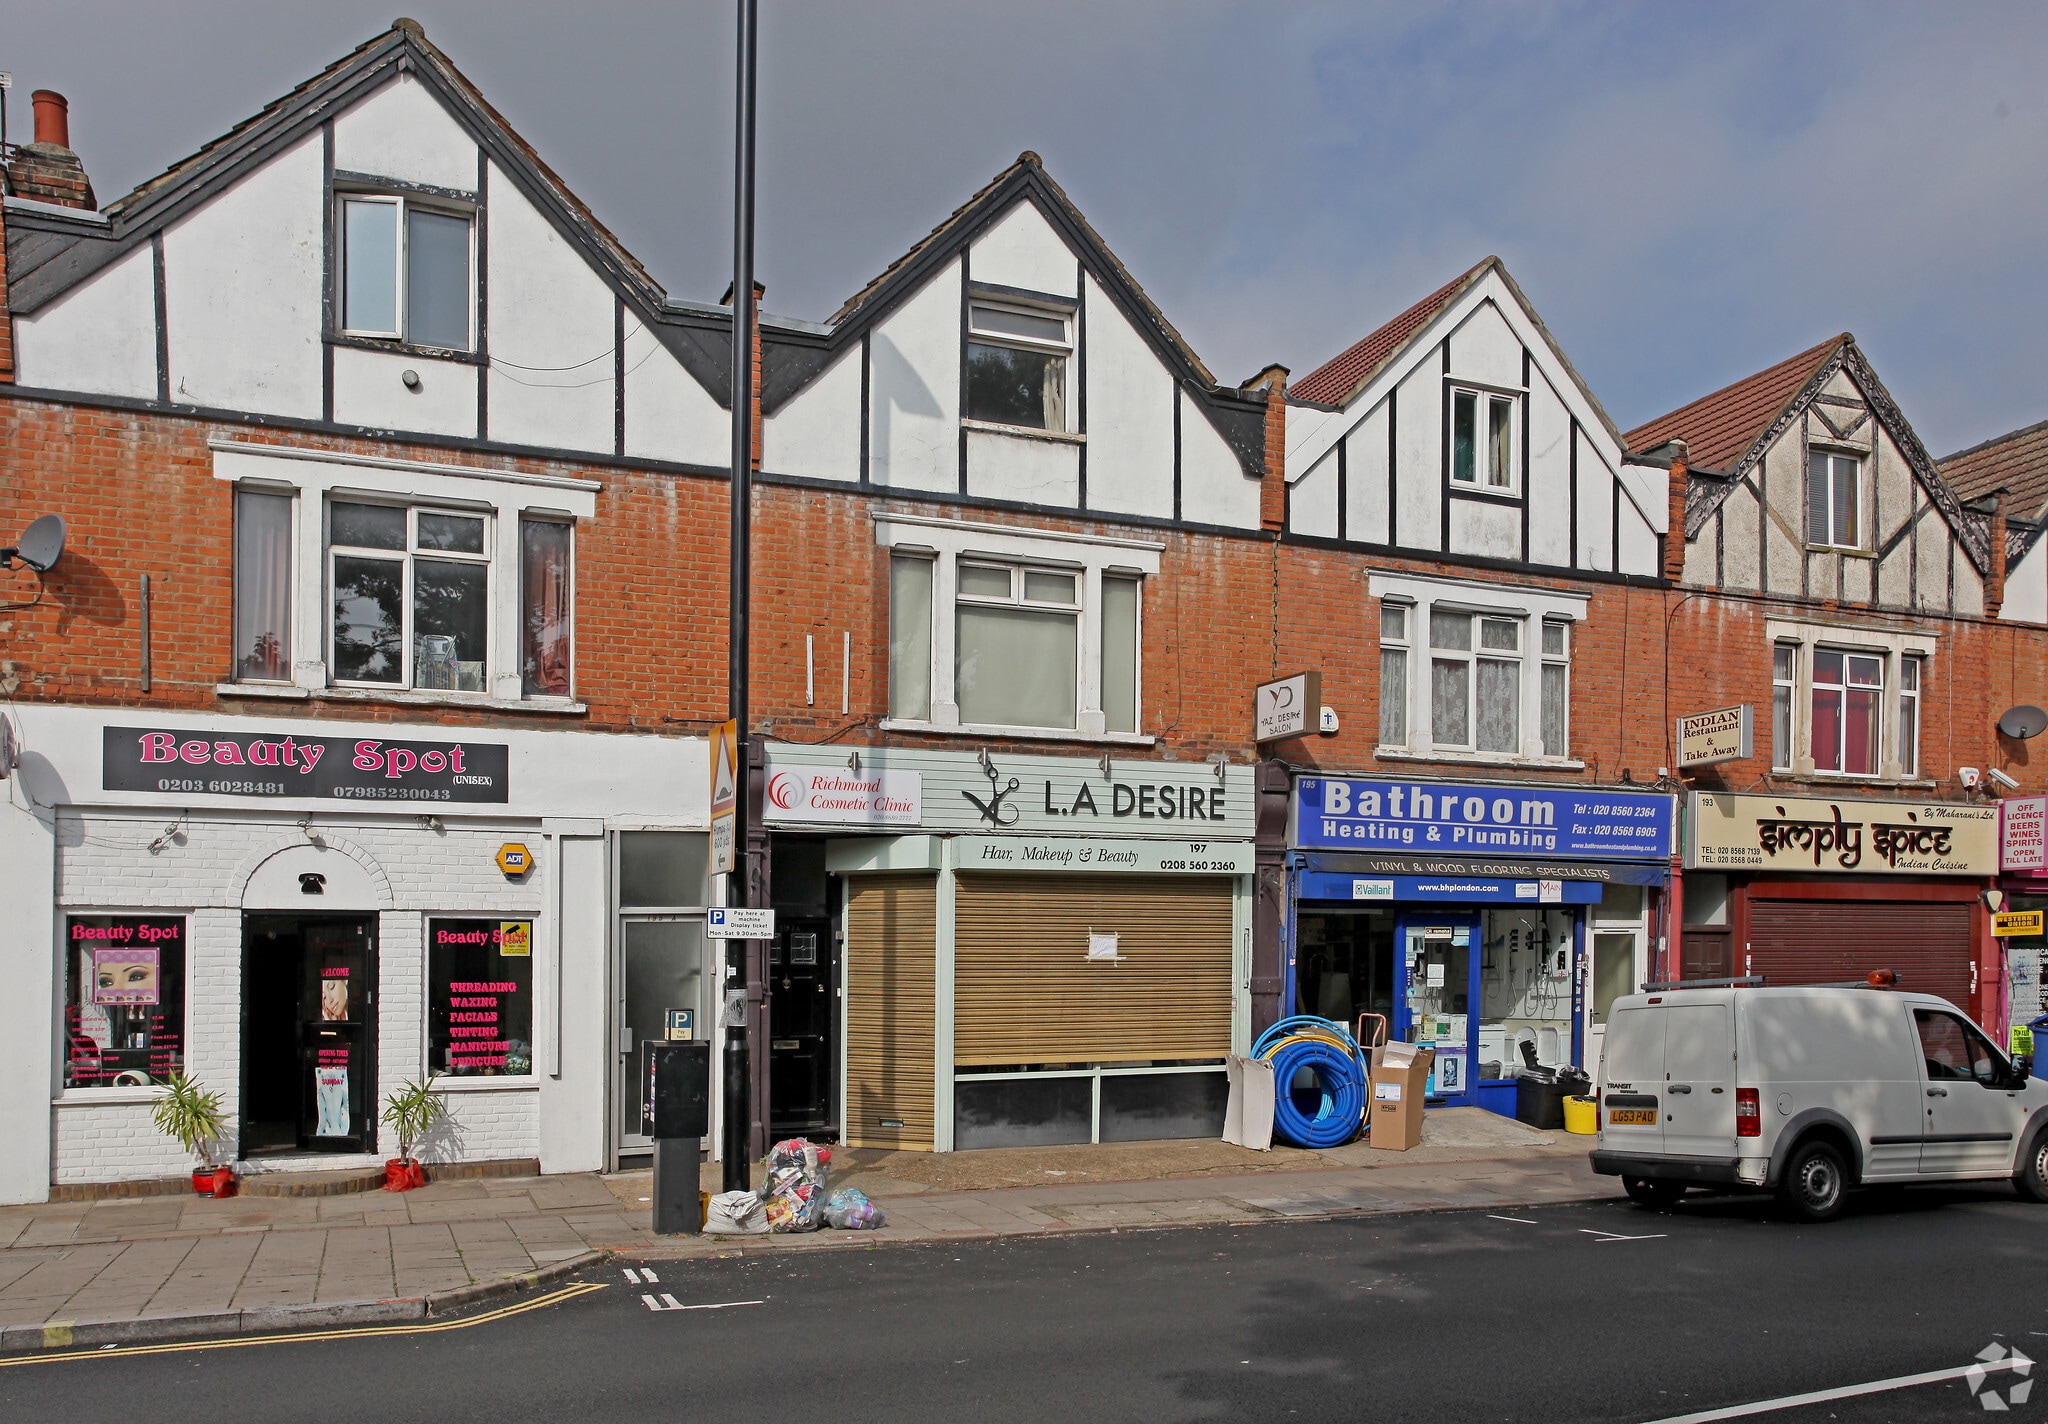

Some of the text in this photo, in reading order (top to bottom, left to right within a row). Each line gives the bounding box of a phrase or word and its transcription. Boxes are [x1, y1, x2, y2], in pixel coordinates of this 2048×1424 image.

[1261, 717, 1273, 727] YAZ
[1684, 711, 1739, 730] INDIAN
[1270, 723, 1291, 735] SALON
[1684, 721, 1739, 738] Restaurant
[1706, 738, 1714, 746] &
[139, 732, 467, 778] Beauty Spot
[1685, 746, 1738, 761] Take Away
[452, 775, 493, 786] (UNISEX)
[811, 776, 881, 793] Richmond
[1302, 780, 1316, 789] 195
[158, 778, 286, 795] 0203 6028481
[333, 785, 451, 800] 07985230043
[811, 795, 914, 812] Cosmetic Clinic
[1045, 780, 1226, 821] L.A DESIRE
[1324, 780, 1554, 825] Bathroom
[1702, 799, 1714, 807] 193
[1573, 804, 1587, 814] Tel
[1593, 805, 1610, 815] 020
[1611, 806, 1633, 816] 8560
[1634, 807, 1656, 818] 2364
[2017, 804, 2035, 812] OFF
[1924, 808, 1934, 819] By
[1980, 810, 1994, 820] Ltd
[2007, 811, 2044, 820] LICENCE
[1572, 824, 1588, 834] Fax
[1594, 825, 1611, 835] 020
[1612, 826, 1634, 836] 8568
[1635, 827, 1657, 837] 6905
[2010, 821, 2040, 830] BEERS
[1323, 820, 1557, 850] Heating & Plumbing
[1756, 805, 1954, 868] simply spice
[2010, 830, 2040, 839] WINES
[1189, 844, 1207, 853] 197
[2006, 838, 2043, 848] SPIRITS
[981, 845, 1139, 866] Hair, Makeup & Beauty
[1731, 847, 1745, 855] 8568
[506, 855, 523, 863] ADT
[1897, 857, 1968, 871] Indian Cuisine
[1160, 860, 1235, 871] 0208 560 2360
[1370, 861, 1610, 879] VINYL & WOOD FLOORING SPECIALISTS
[1363, 884, 1391, 895] Vaillant
[1418, 884, 1499, 892] www.bhplondon.com
[713, 911, 723, 924] P
[72, 924, 179, 942] Beauty Spot
[437, 929, 526, 946] Beauty Spot
[320, 967, 350, 977] WELCOME
[450, 982, 517, 993] THREADING
[450, 997, 497, 1007] WAXING
[450, 1012, 498, 1022] FACIALS
[675, 1012, 688, 1028] P
[450, 1027, 498, 1037] TINTING
[450, 1041, 510, 1052] MANICURE
[450, 1056, 506, 1067] PEDICURE
[1613, 1111, 1635, 1122] LG53
